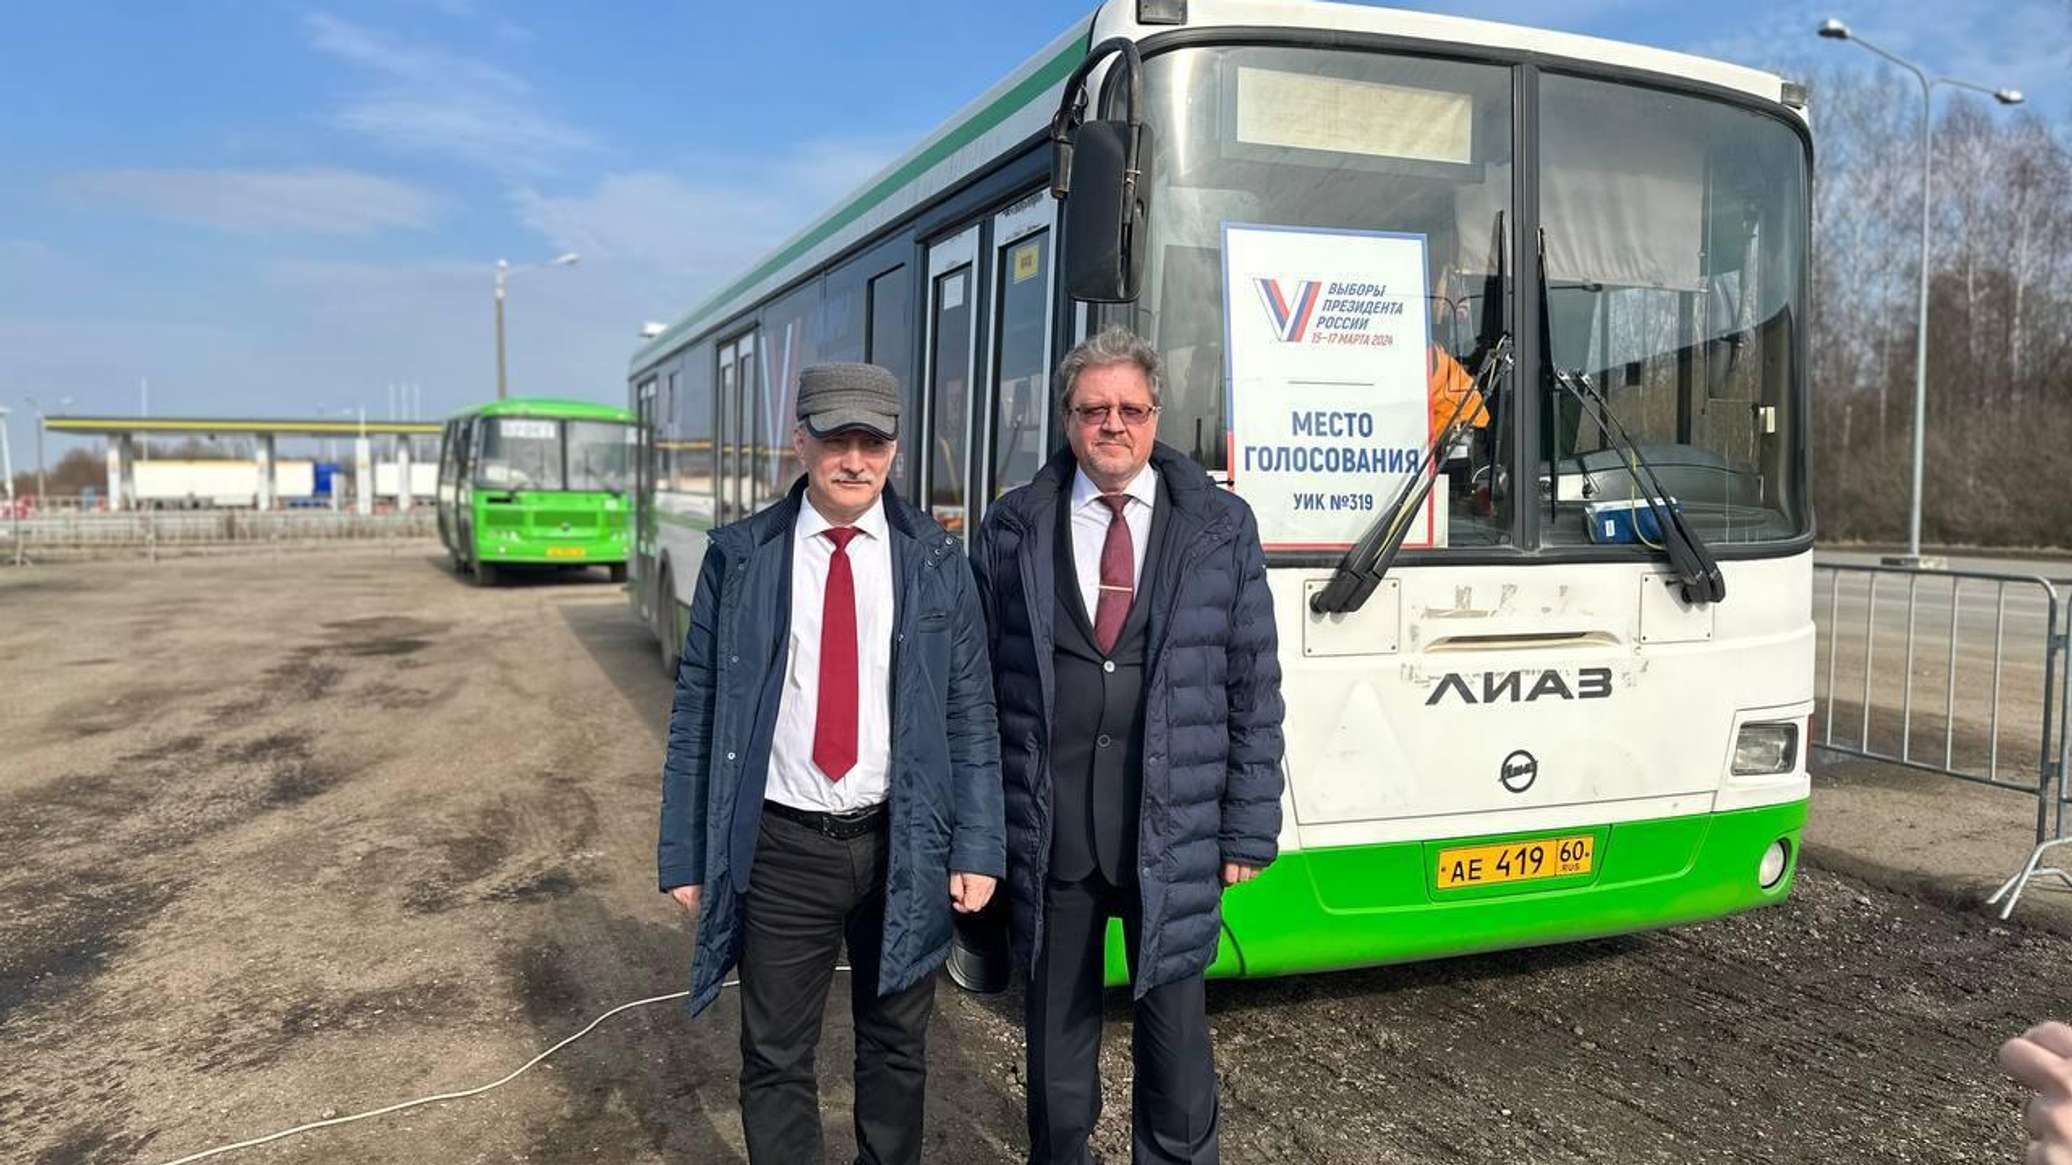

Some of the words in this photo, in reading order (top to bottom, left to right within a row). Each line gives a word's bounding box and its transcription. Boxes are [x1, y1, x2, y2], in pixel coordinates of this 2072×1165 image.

[1328, 282, 1386, 297] ВЫБОРЫ
[1322, 299, 1404, 315] ПРЕЗИДЕНТА
[1316, 316, 1370, 330] РОССИИ
[1338, 333, 1370, 345] МАРТА
[1371, 334, 1394, 346] 2024
[1292, 411, 1373, 438] МЕСТО
[1244, 446, 1420, 474] ГОЛОСОВАНИЯ
[1293, 493, 1326, 510] УИК
[1330, 494, 1373, 511] №319
[1425, 667, 1613, 706] ЛИАЗ
[1496, 846, 1544, 877] 419
[1560, 840, 1585, 862] 60
[1561, 862, 1580, 872] RUS
